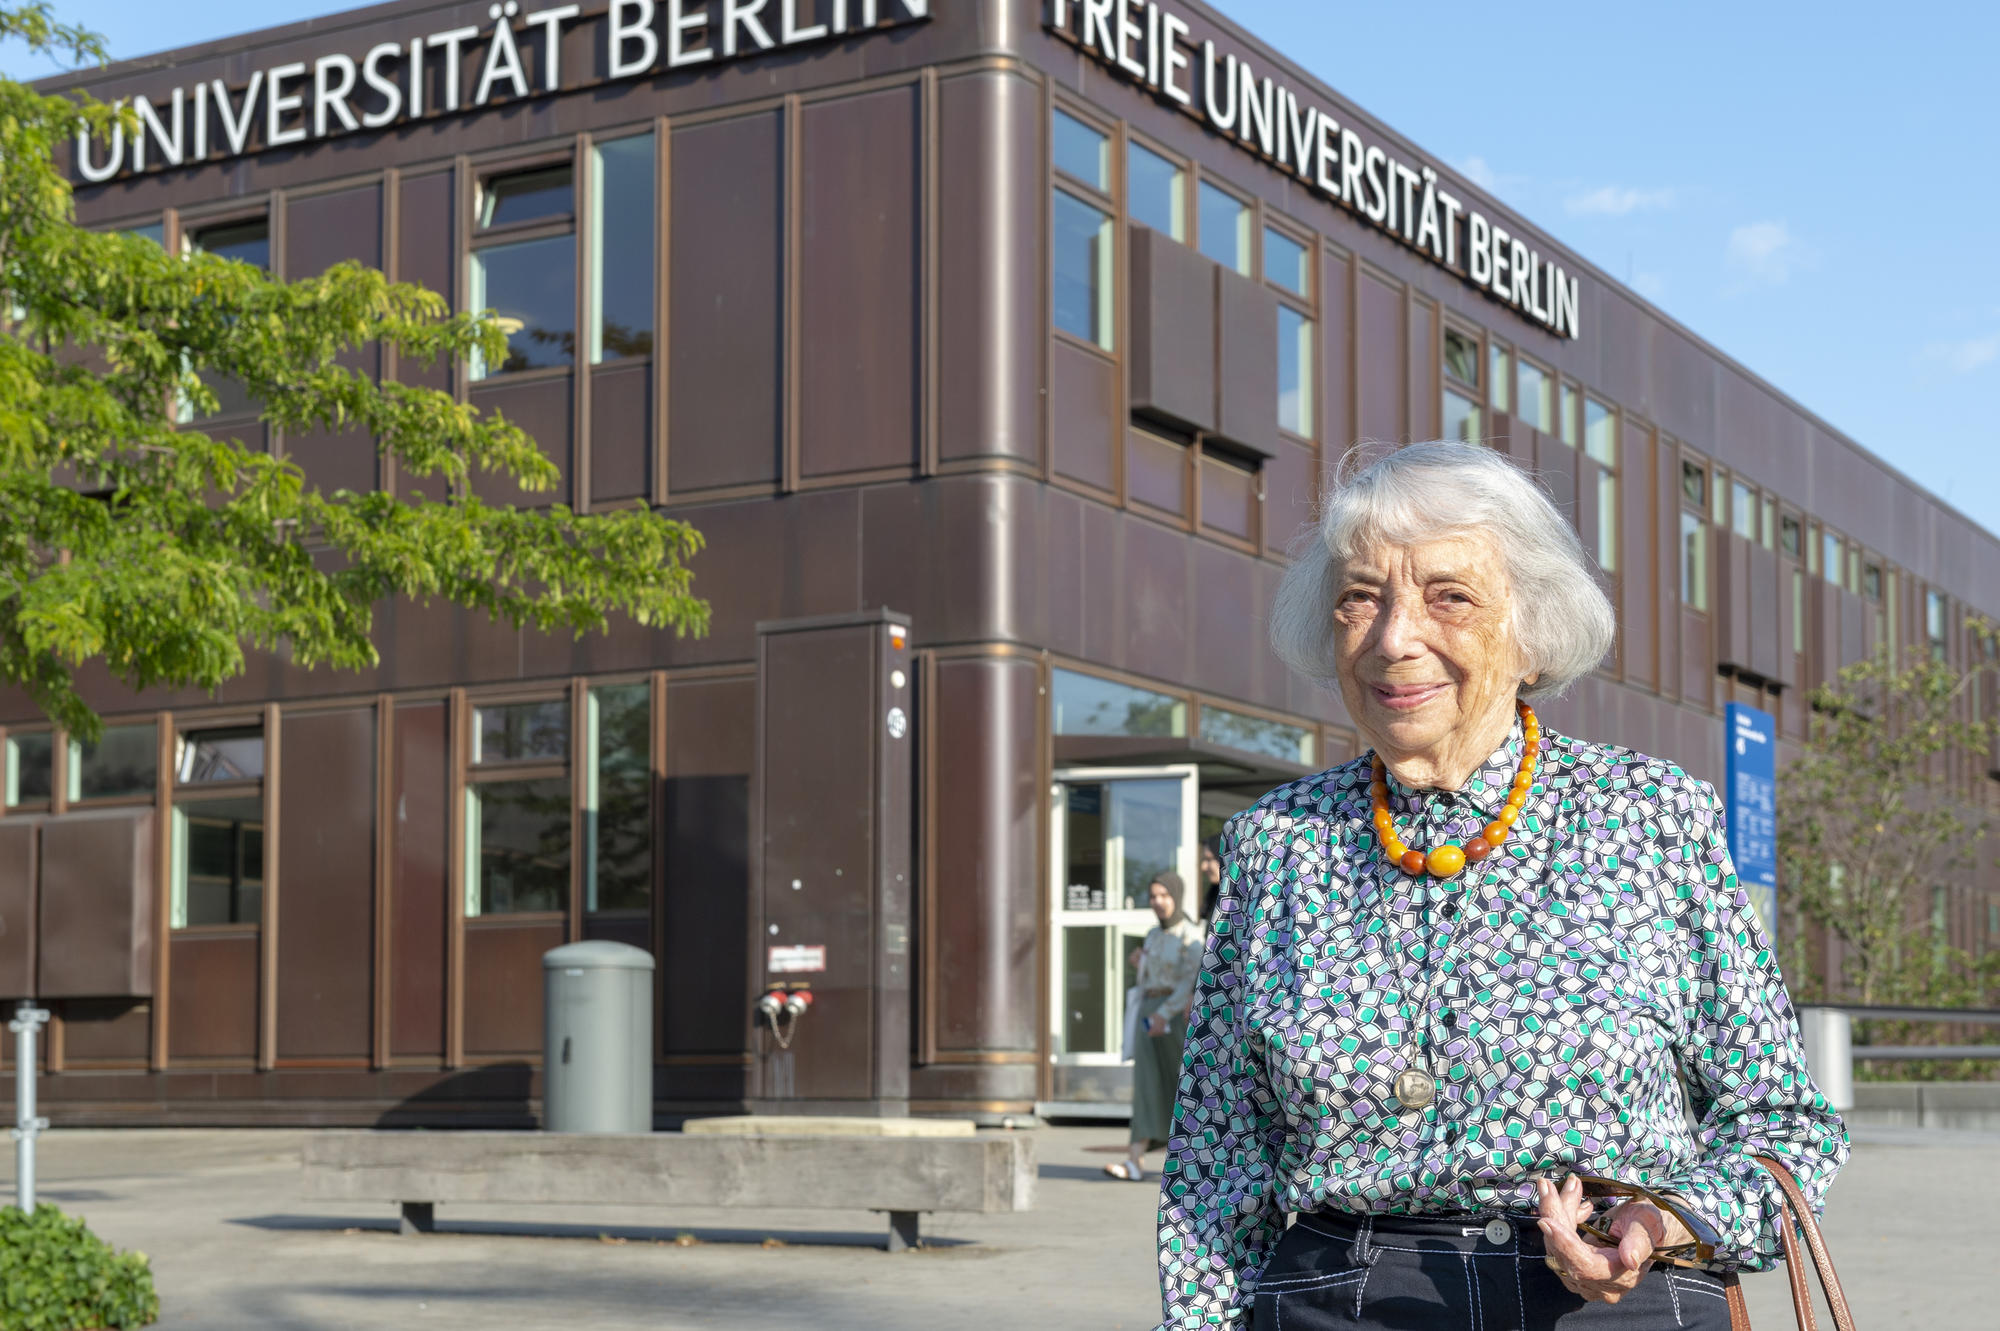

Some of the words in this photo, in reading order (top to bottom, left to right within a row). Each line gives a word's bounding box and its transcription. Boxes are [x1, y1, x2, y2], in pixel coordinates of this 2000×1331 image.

[78, 1, 579, 182] UNIVERSITÄT
[608, 0, 929, 79] BERL
[1205, 39, 1462, 265] UNIVERSITÄT
[1469, 213, 1579, 340] BERLIN
